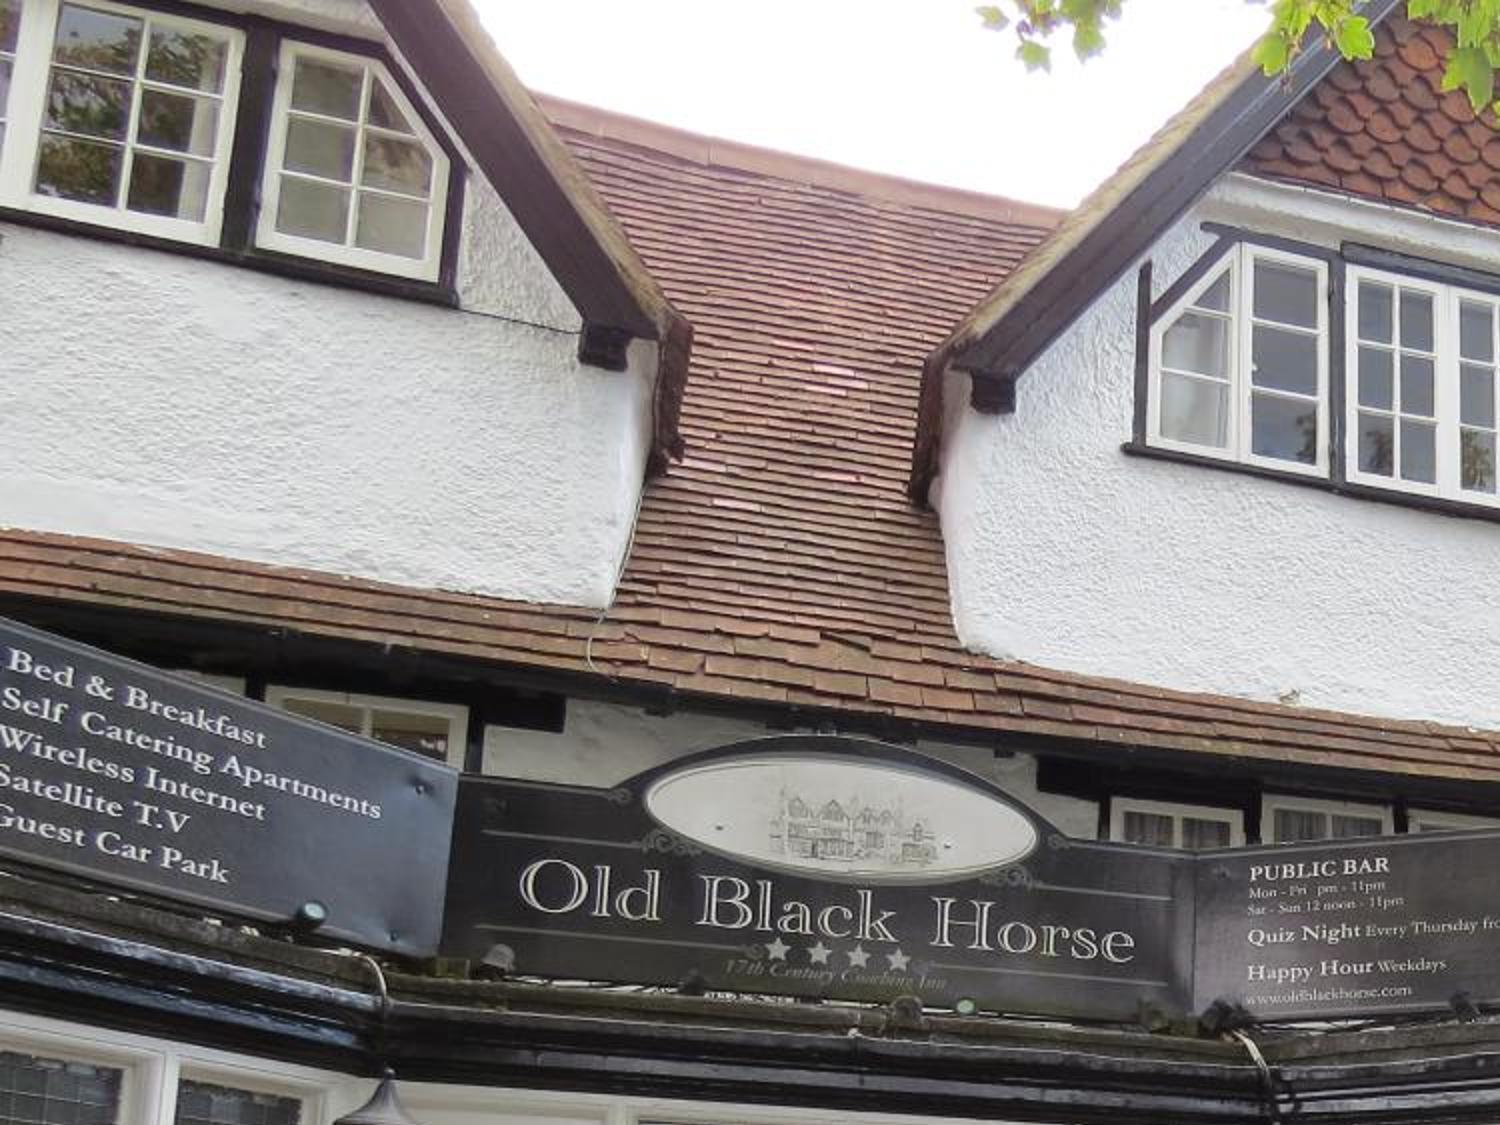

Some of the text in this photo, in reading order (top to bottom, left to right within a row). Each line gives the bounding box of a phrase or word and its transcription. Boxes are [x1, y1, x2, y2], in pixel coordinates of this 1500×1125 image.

[7, 647, 267, 748] Bed & Breakfast
[0, 725, 267, 821] Wireless Internet
[2, 687, 382, 820] Self Catering Apartments
[0, 764, 191, 834] Satellite T.V
[0, 804, 229, 884] Guest Car Park
[1249, 888, 1277, 900] Mon
[1352, 881, 1386, 893] 11pm
[1250, 857, 1390, 881] PUBLIC BAR
[519, 858, 1135, 964] Old Black Horse
[1279, 902, 1301, 914] Sun
[1306, 900, 1321, 911] 12
[1323, 899, 1356, 911] noon
[1370, 896, 1405, 910] 11pm
[1248, 927, 1296, 946] Quiz
[1301, 923, 1361, 945] Night
[1365, 924, 1406, 939] Every
[1411, 920, 1478, 934] Thursday
[724, 960, 765, 977] 17th
[769, 960, 834, 985] Century
[1248, 958, 1448, 984] Happy Hour Weekdays
